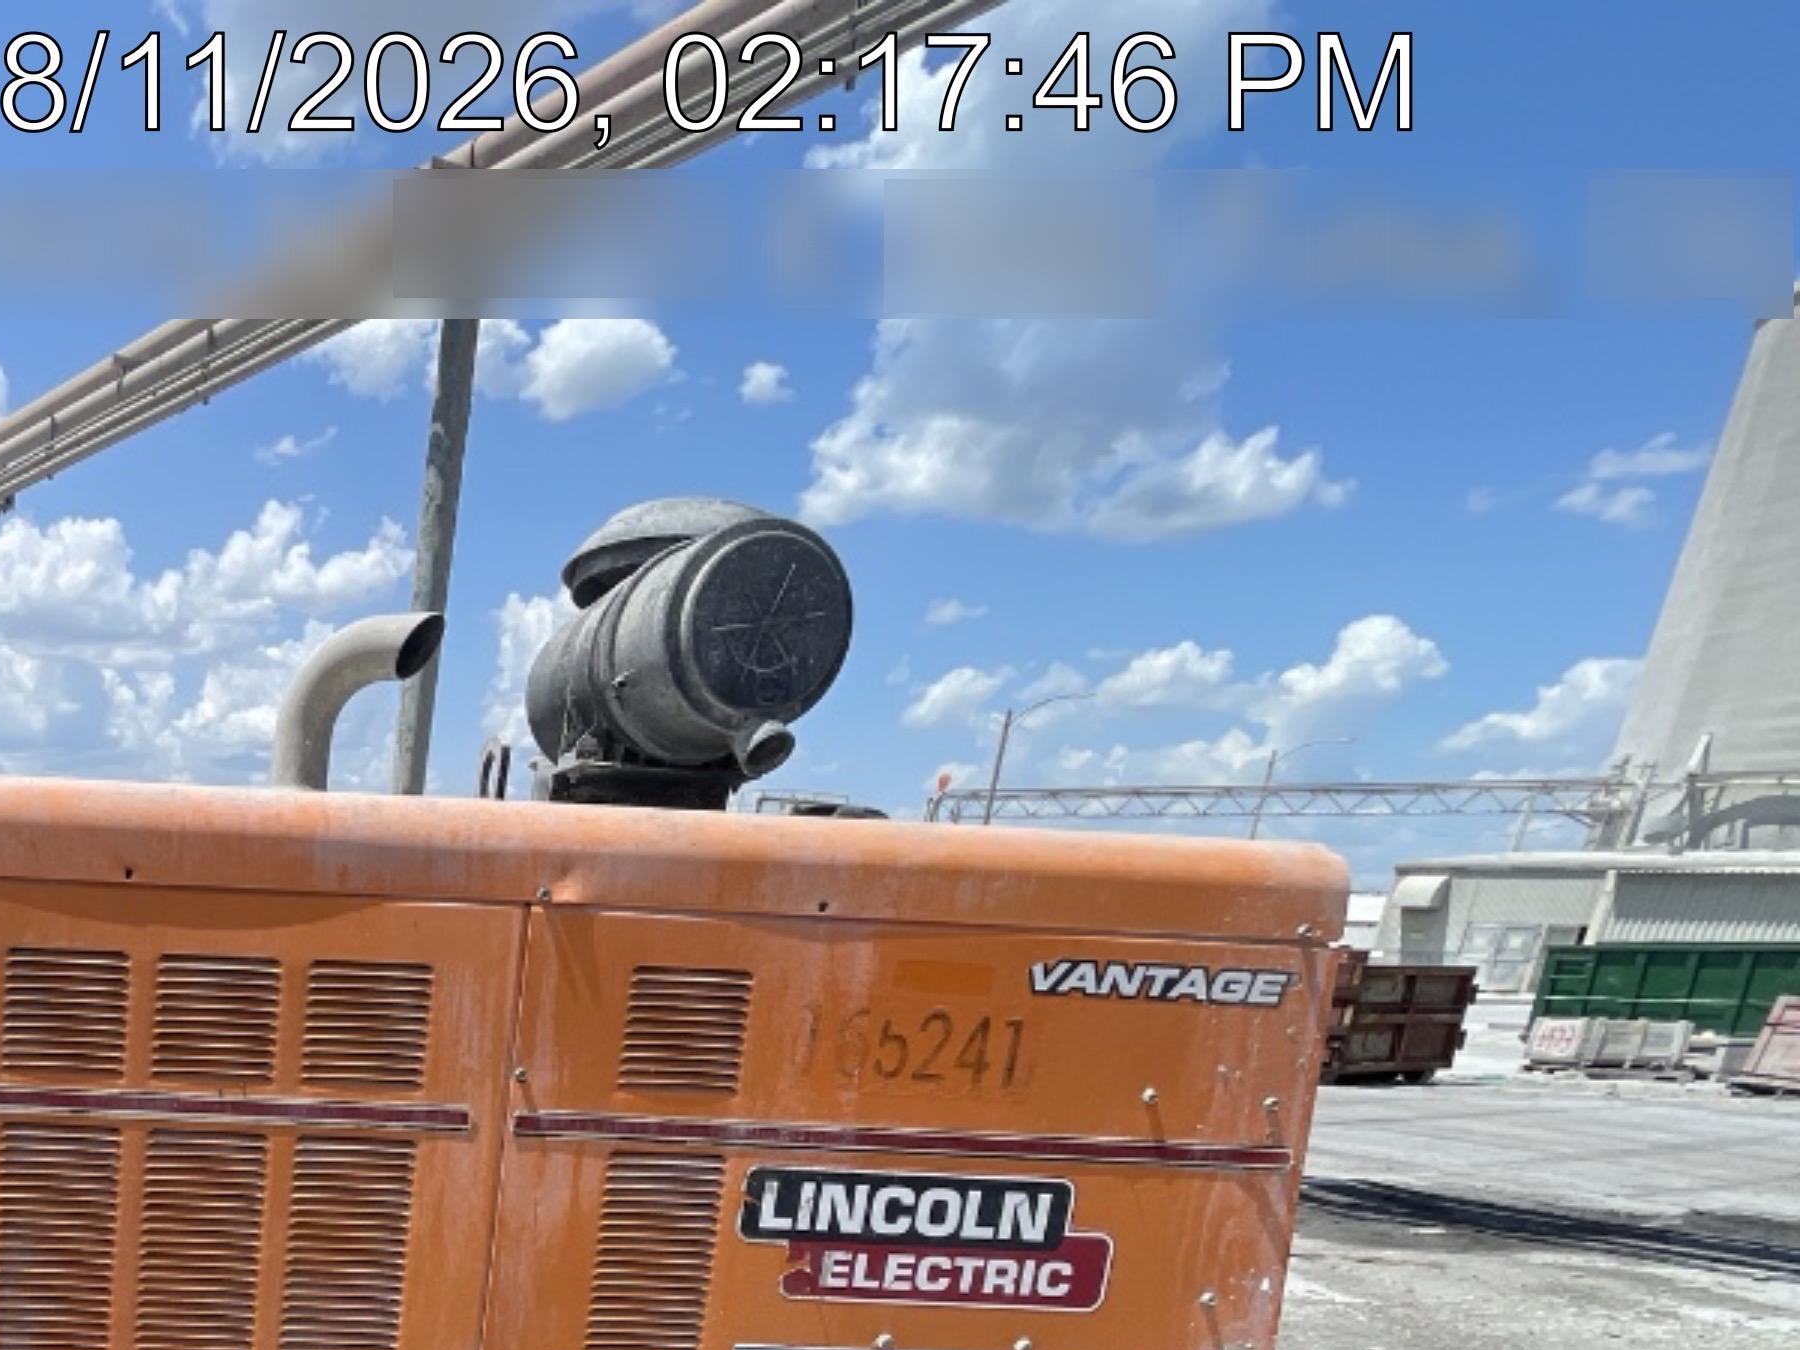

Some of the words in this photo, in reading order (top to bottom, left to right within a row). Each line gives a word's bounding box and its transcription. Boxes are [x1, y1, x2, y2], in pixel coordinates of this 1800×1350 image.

[1030, 961, 1290, 1005] VANTAGE
[757, 1180, 1054, 1243] LINCOLN
[817, 1249, 1075, 1297] ELECTRIC
